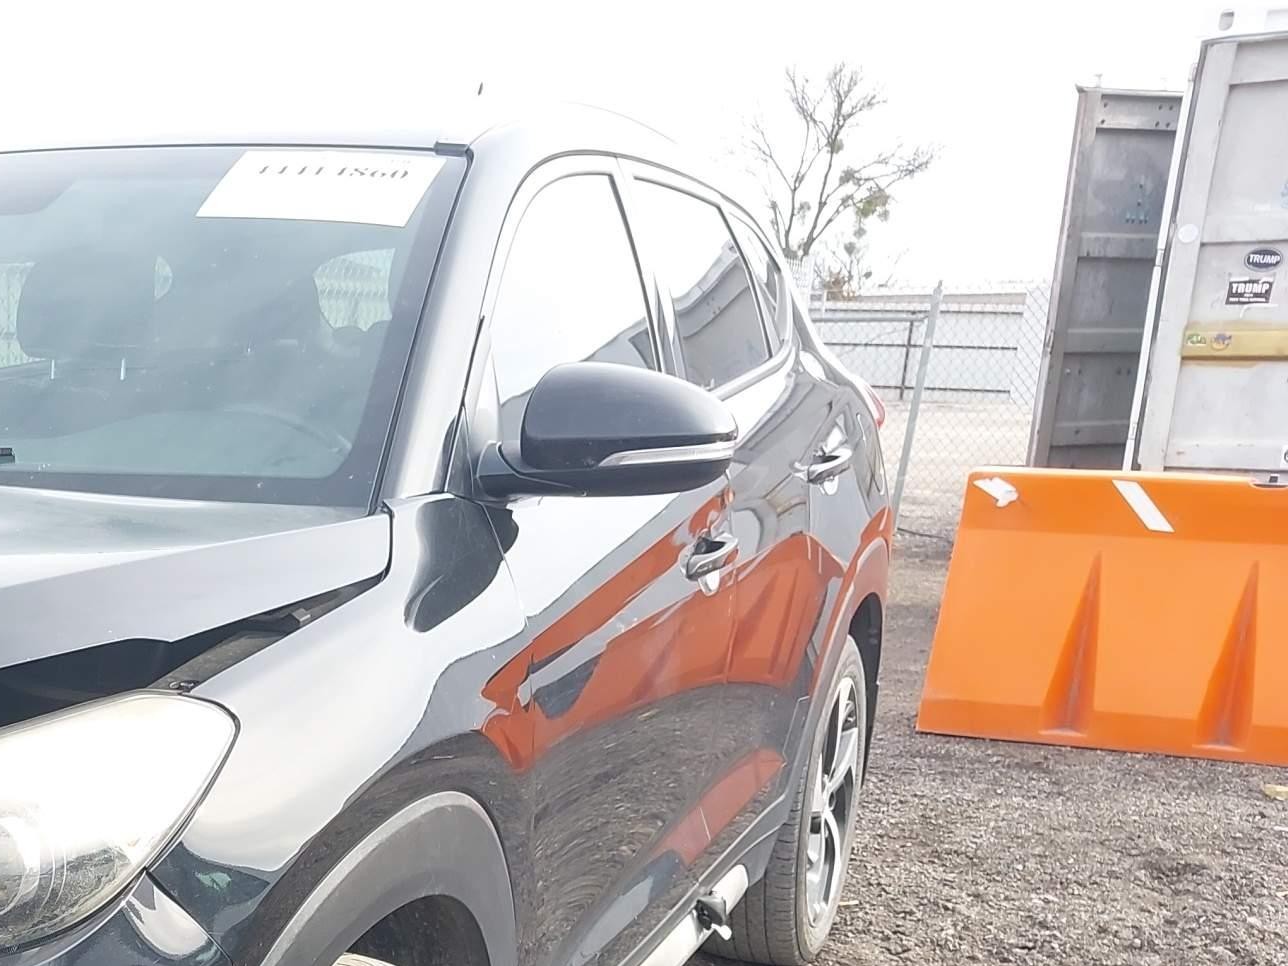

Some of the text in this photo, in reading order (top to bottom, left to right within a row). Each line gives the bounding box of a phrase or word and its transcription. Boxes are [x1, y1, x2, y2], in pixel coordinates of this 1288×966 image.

[259, 166, 409, 179] 1860
[1249, 254, 1281, 265] TRUMP
[1232, 283, 1270, 293] TRUMP
